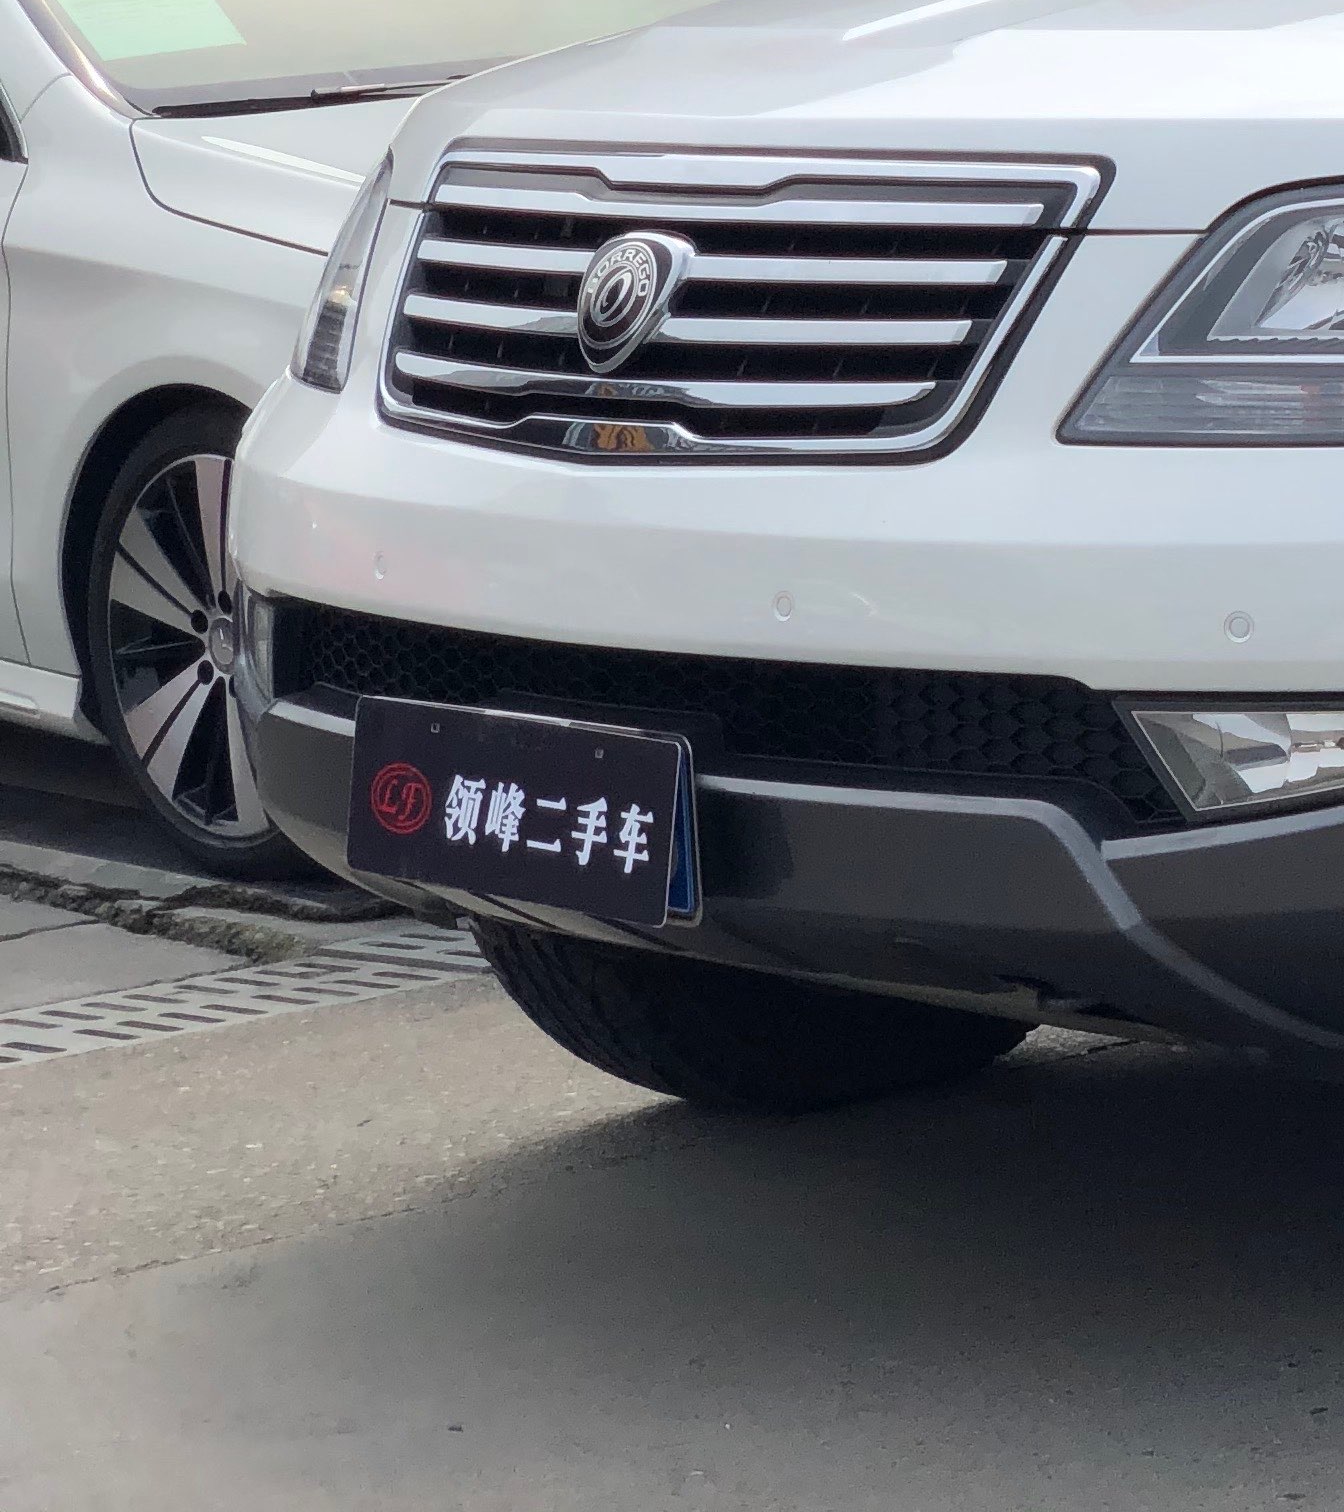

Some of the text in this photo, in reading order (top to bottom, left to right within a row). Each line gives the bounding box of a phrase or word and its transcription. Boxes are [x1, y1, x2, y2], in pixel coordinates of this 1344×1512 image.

[586, 248, 651, 297] BORREGO
[444, 773, 655, 875] 领峰二手车
